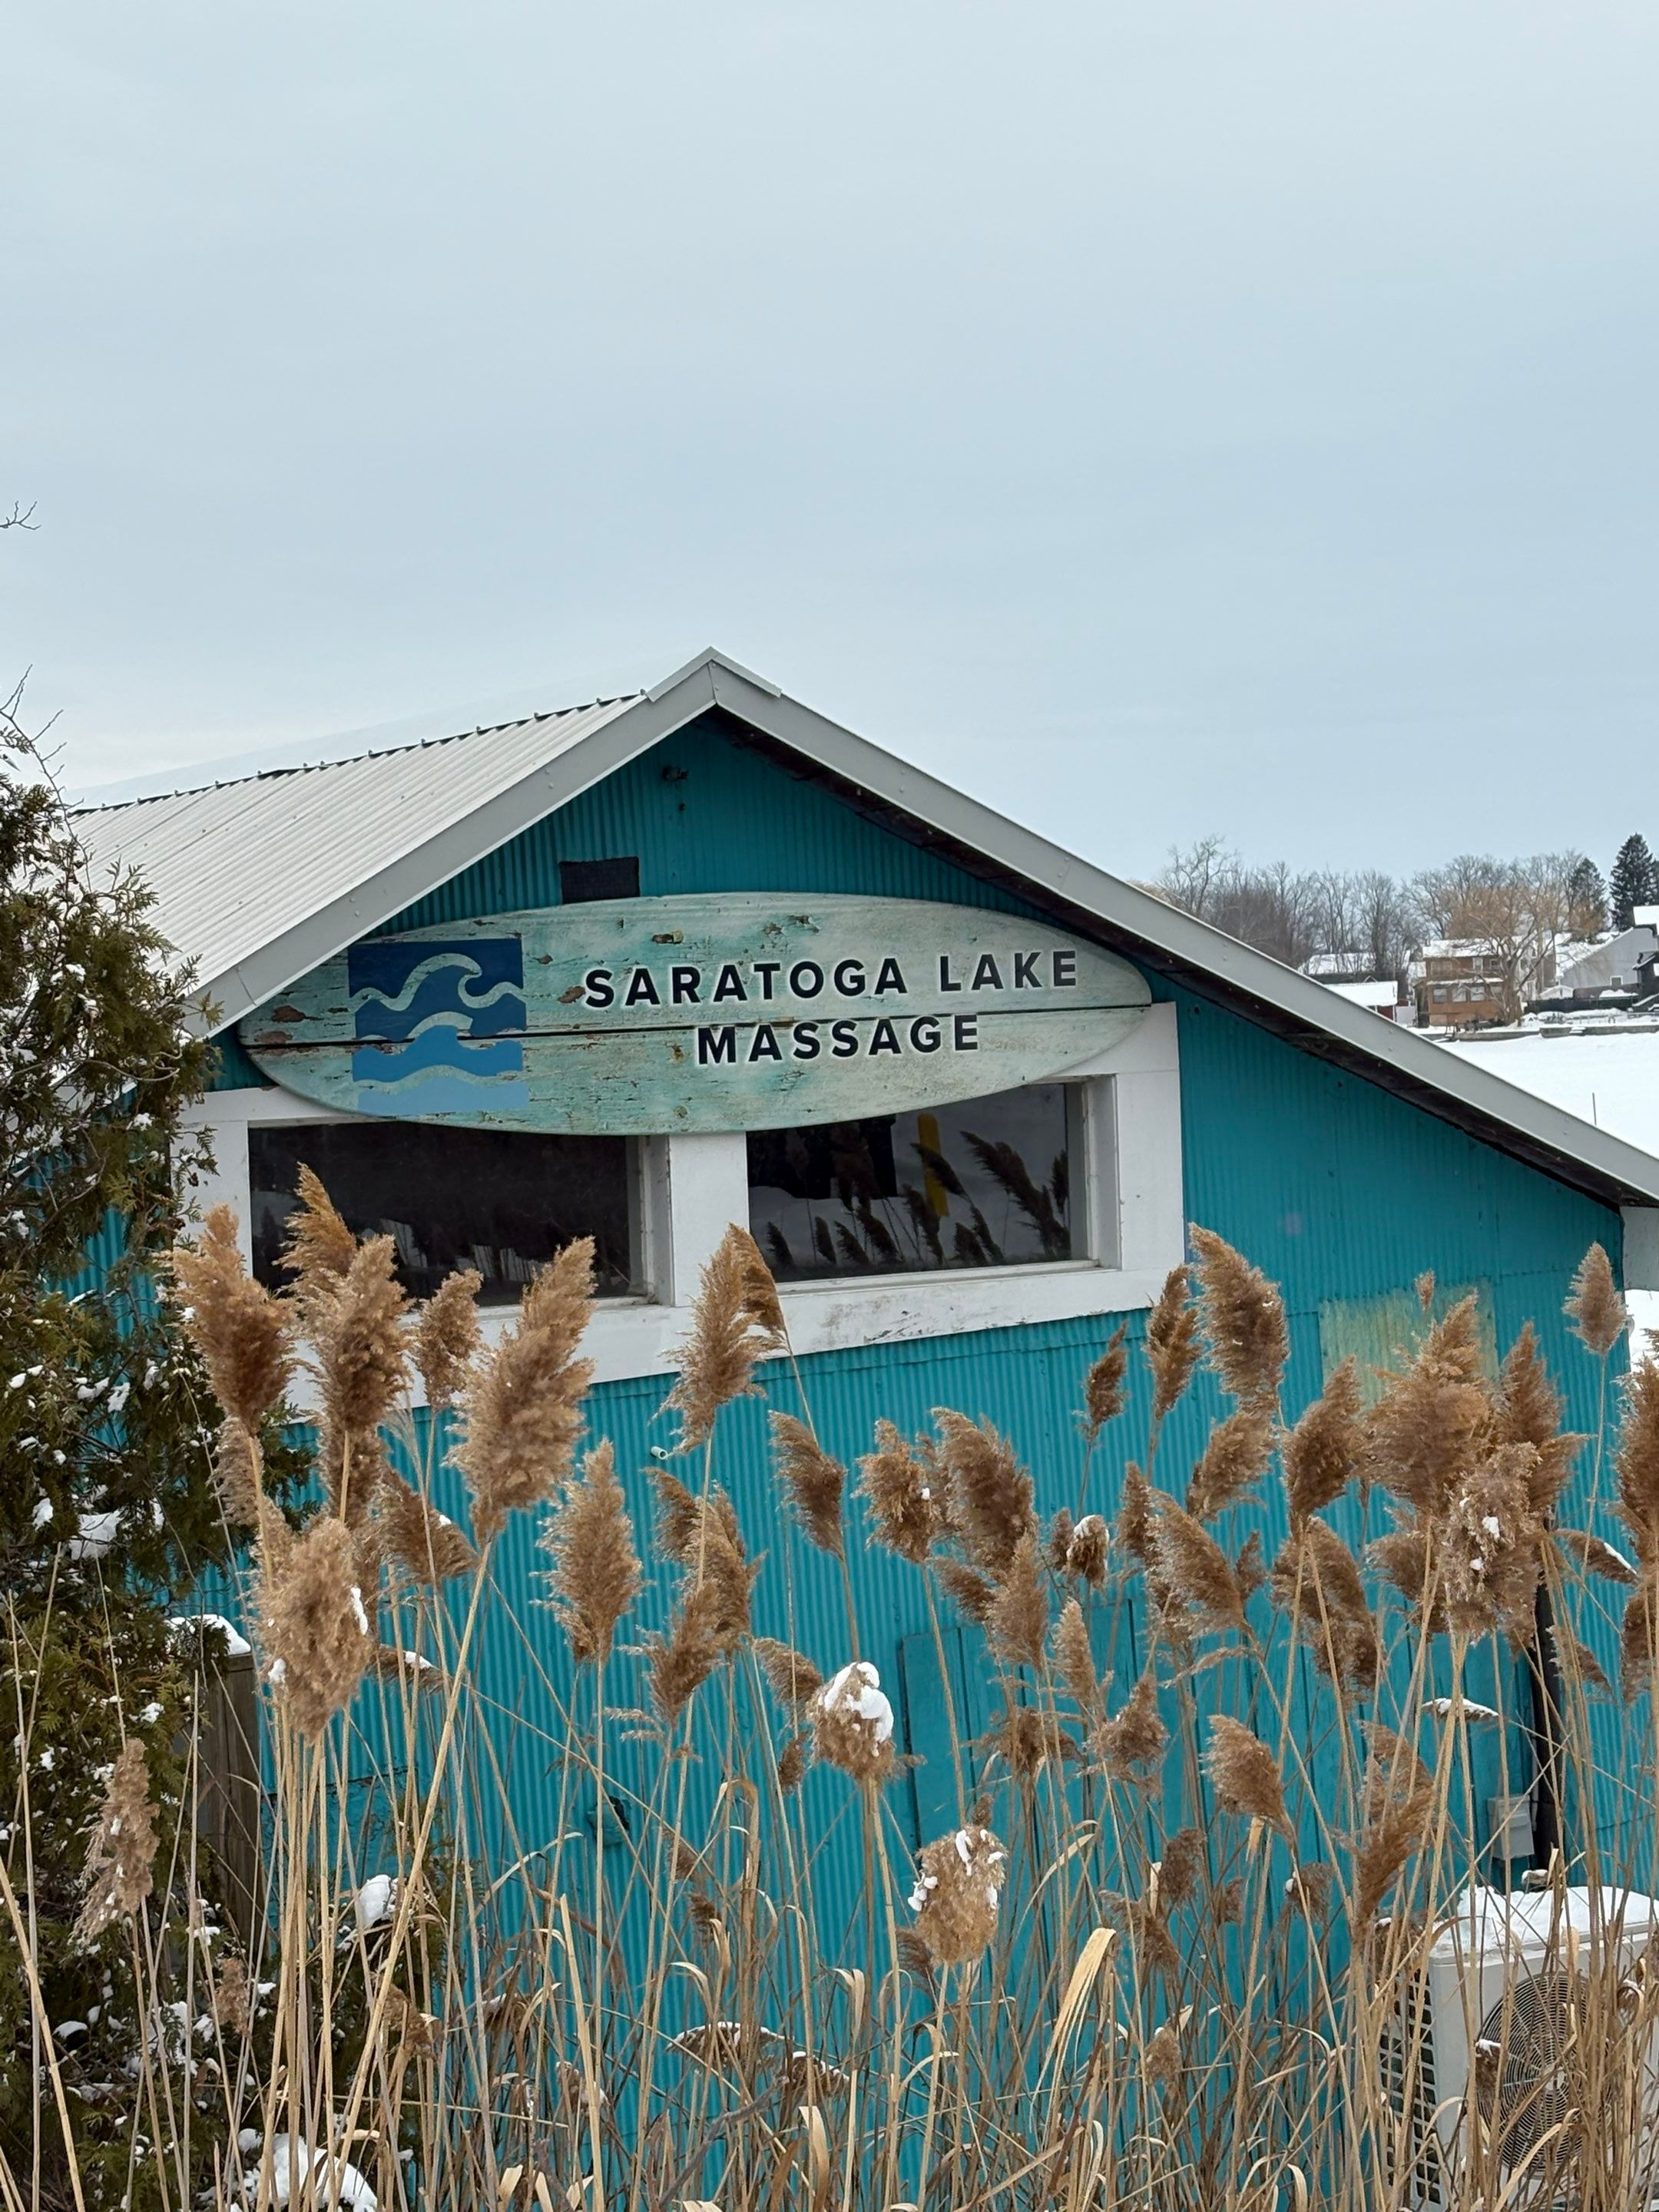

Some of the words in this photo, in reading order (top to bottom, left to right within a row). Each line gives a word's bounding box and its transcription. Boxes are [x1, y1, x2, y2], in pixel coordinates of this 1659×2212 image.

[584, 958, 908, 1008] SARATOGA
[939, 951, 1076, 992] LAKE
[697, 1014, 979, 1065] MASSAGE
